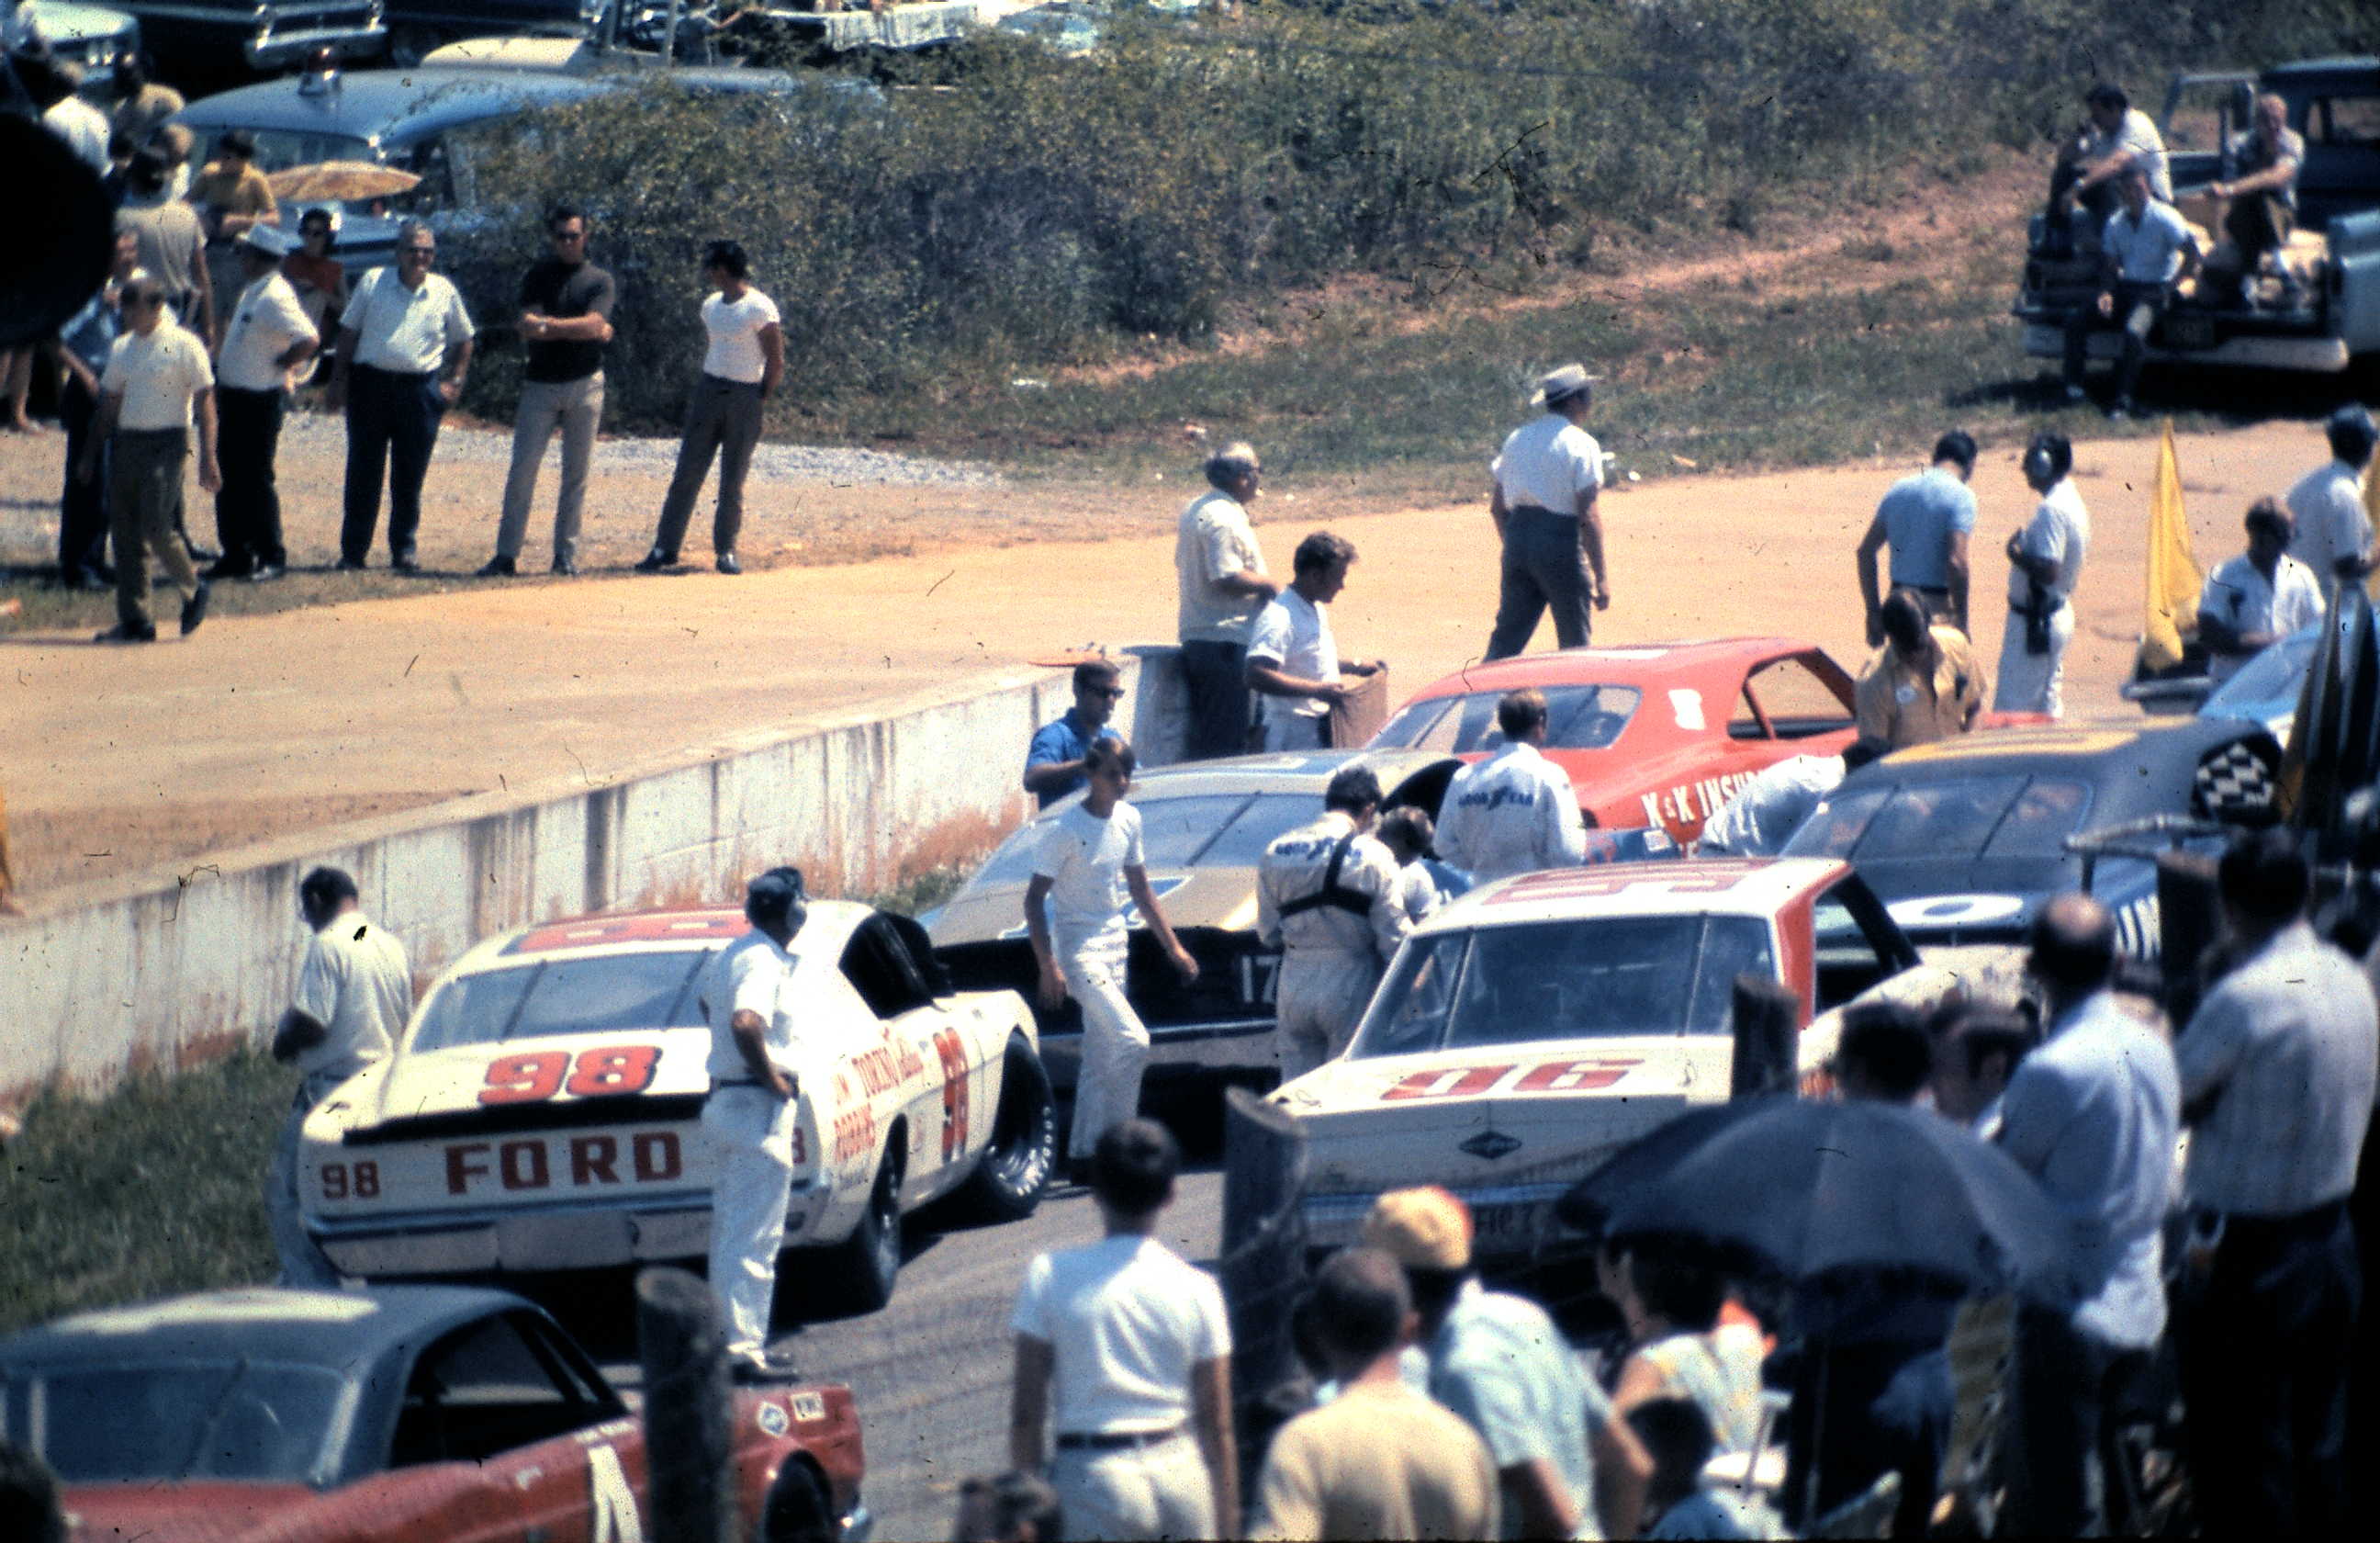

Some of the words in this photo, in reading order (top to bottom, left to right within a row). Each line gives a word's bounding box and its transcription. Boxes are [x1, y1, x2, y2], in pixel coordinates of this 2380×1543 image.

[1640, 791, 1667, 829] K
[1664, 795, 1677, 818] &
[1672, 784, 1696, 823] K
[1241, 955, 1280, 1003] 17
[477, 1045, 664, 1105] 98
[320, 1160, 381, 1199] 98
[444, 1132, 683, 1195] FORD
